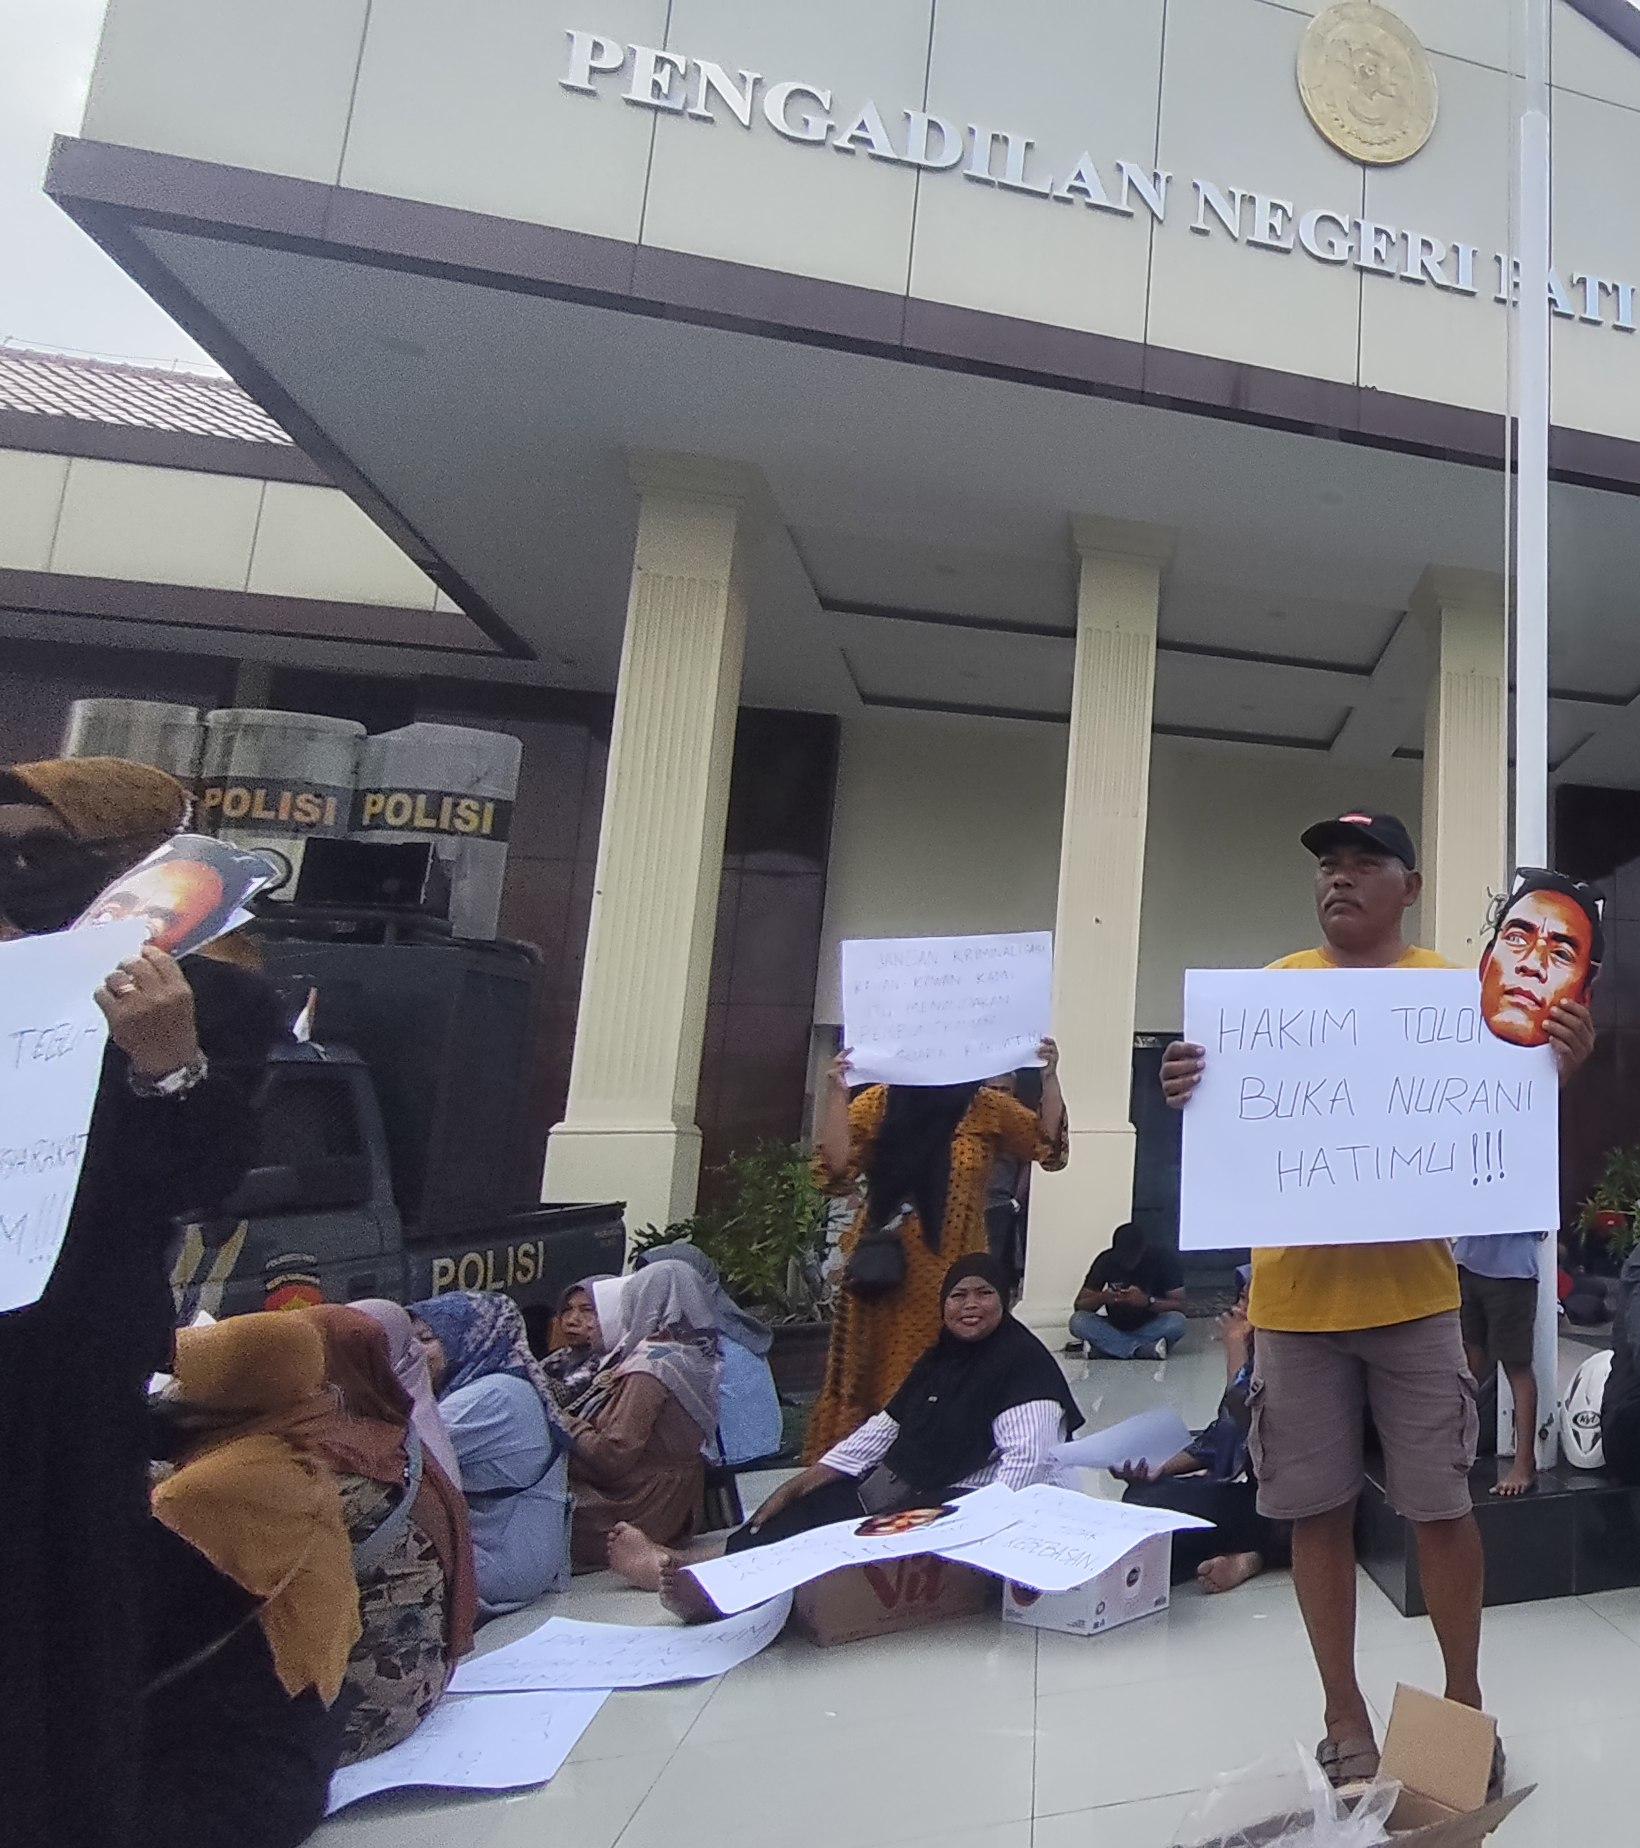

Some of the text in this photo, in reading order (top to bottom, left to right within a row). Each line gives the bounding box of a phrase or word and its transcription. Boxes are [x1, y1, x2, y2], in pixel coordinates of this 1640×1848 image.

[558, 29, 1173, 223] PENGADILAN
[1189, 179, 1479, 296] NEGERI
[203, 786, 337, 827] POLISI
[363, 793, 496, 834] POLISI
[1219, 1006, 1483, 1054] HAKIM TOLO
[1238, 1076, 1533, 1121] BUKA NURANI
[432, 1240, 545, 1297] POLISI
